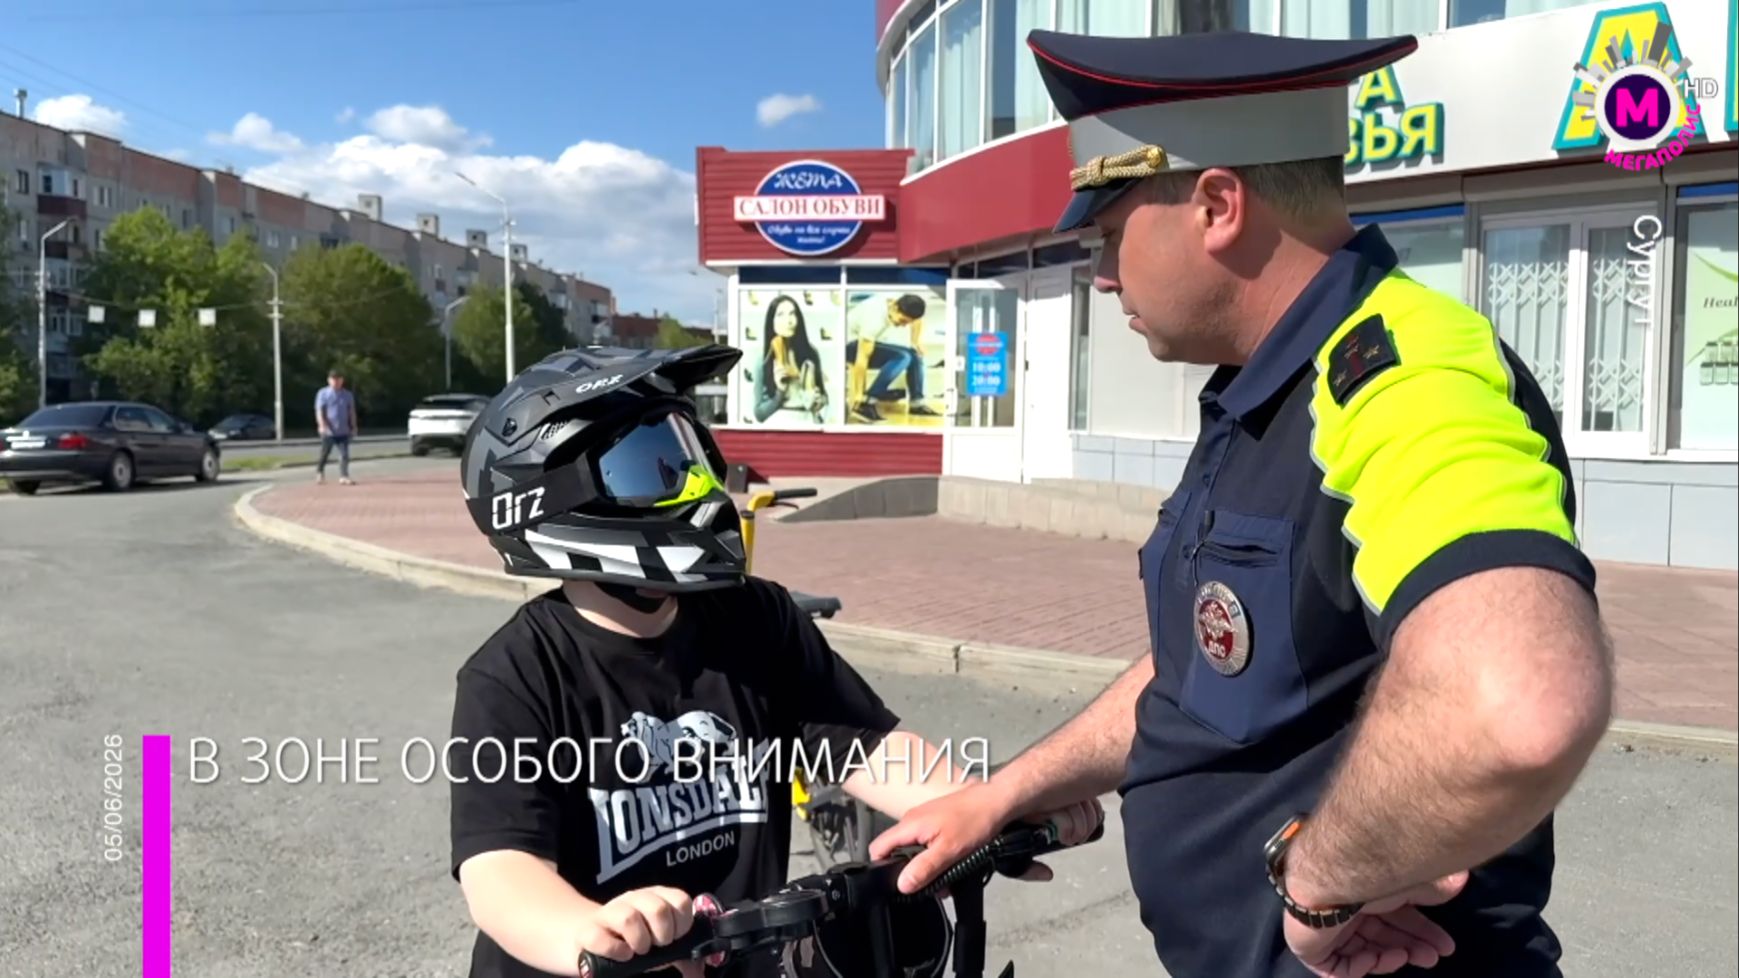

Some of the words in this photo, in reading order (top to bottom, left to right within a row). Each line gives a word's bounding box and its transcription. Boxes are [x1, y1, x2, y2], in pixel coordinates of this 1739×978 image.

[739, 198, 807, 216] САЛОН
[813, 198, 880, 215] ОБУВИ
[666, 831, 735, 867] LONDON
